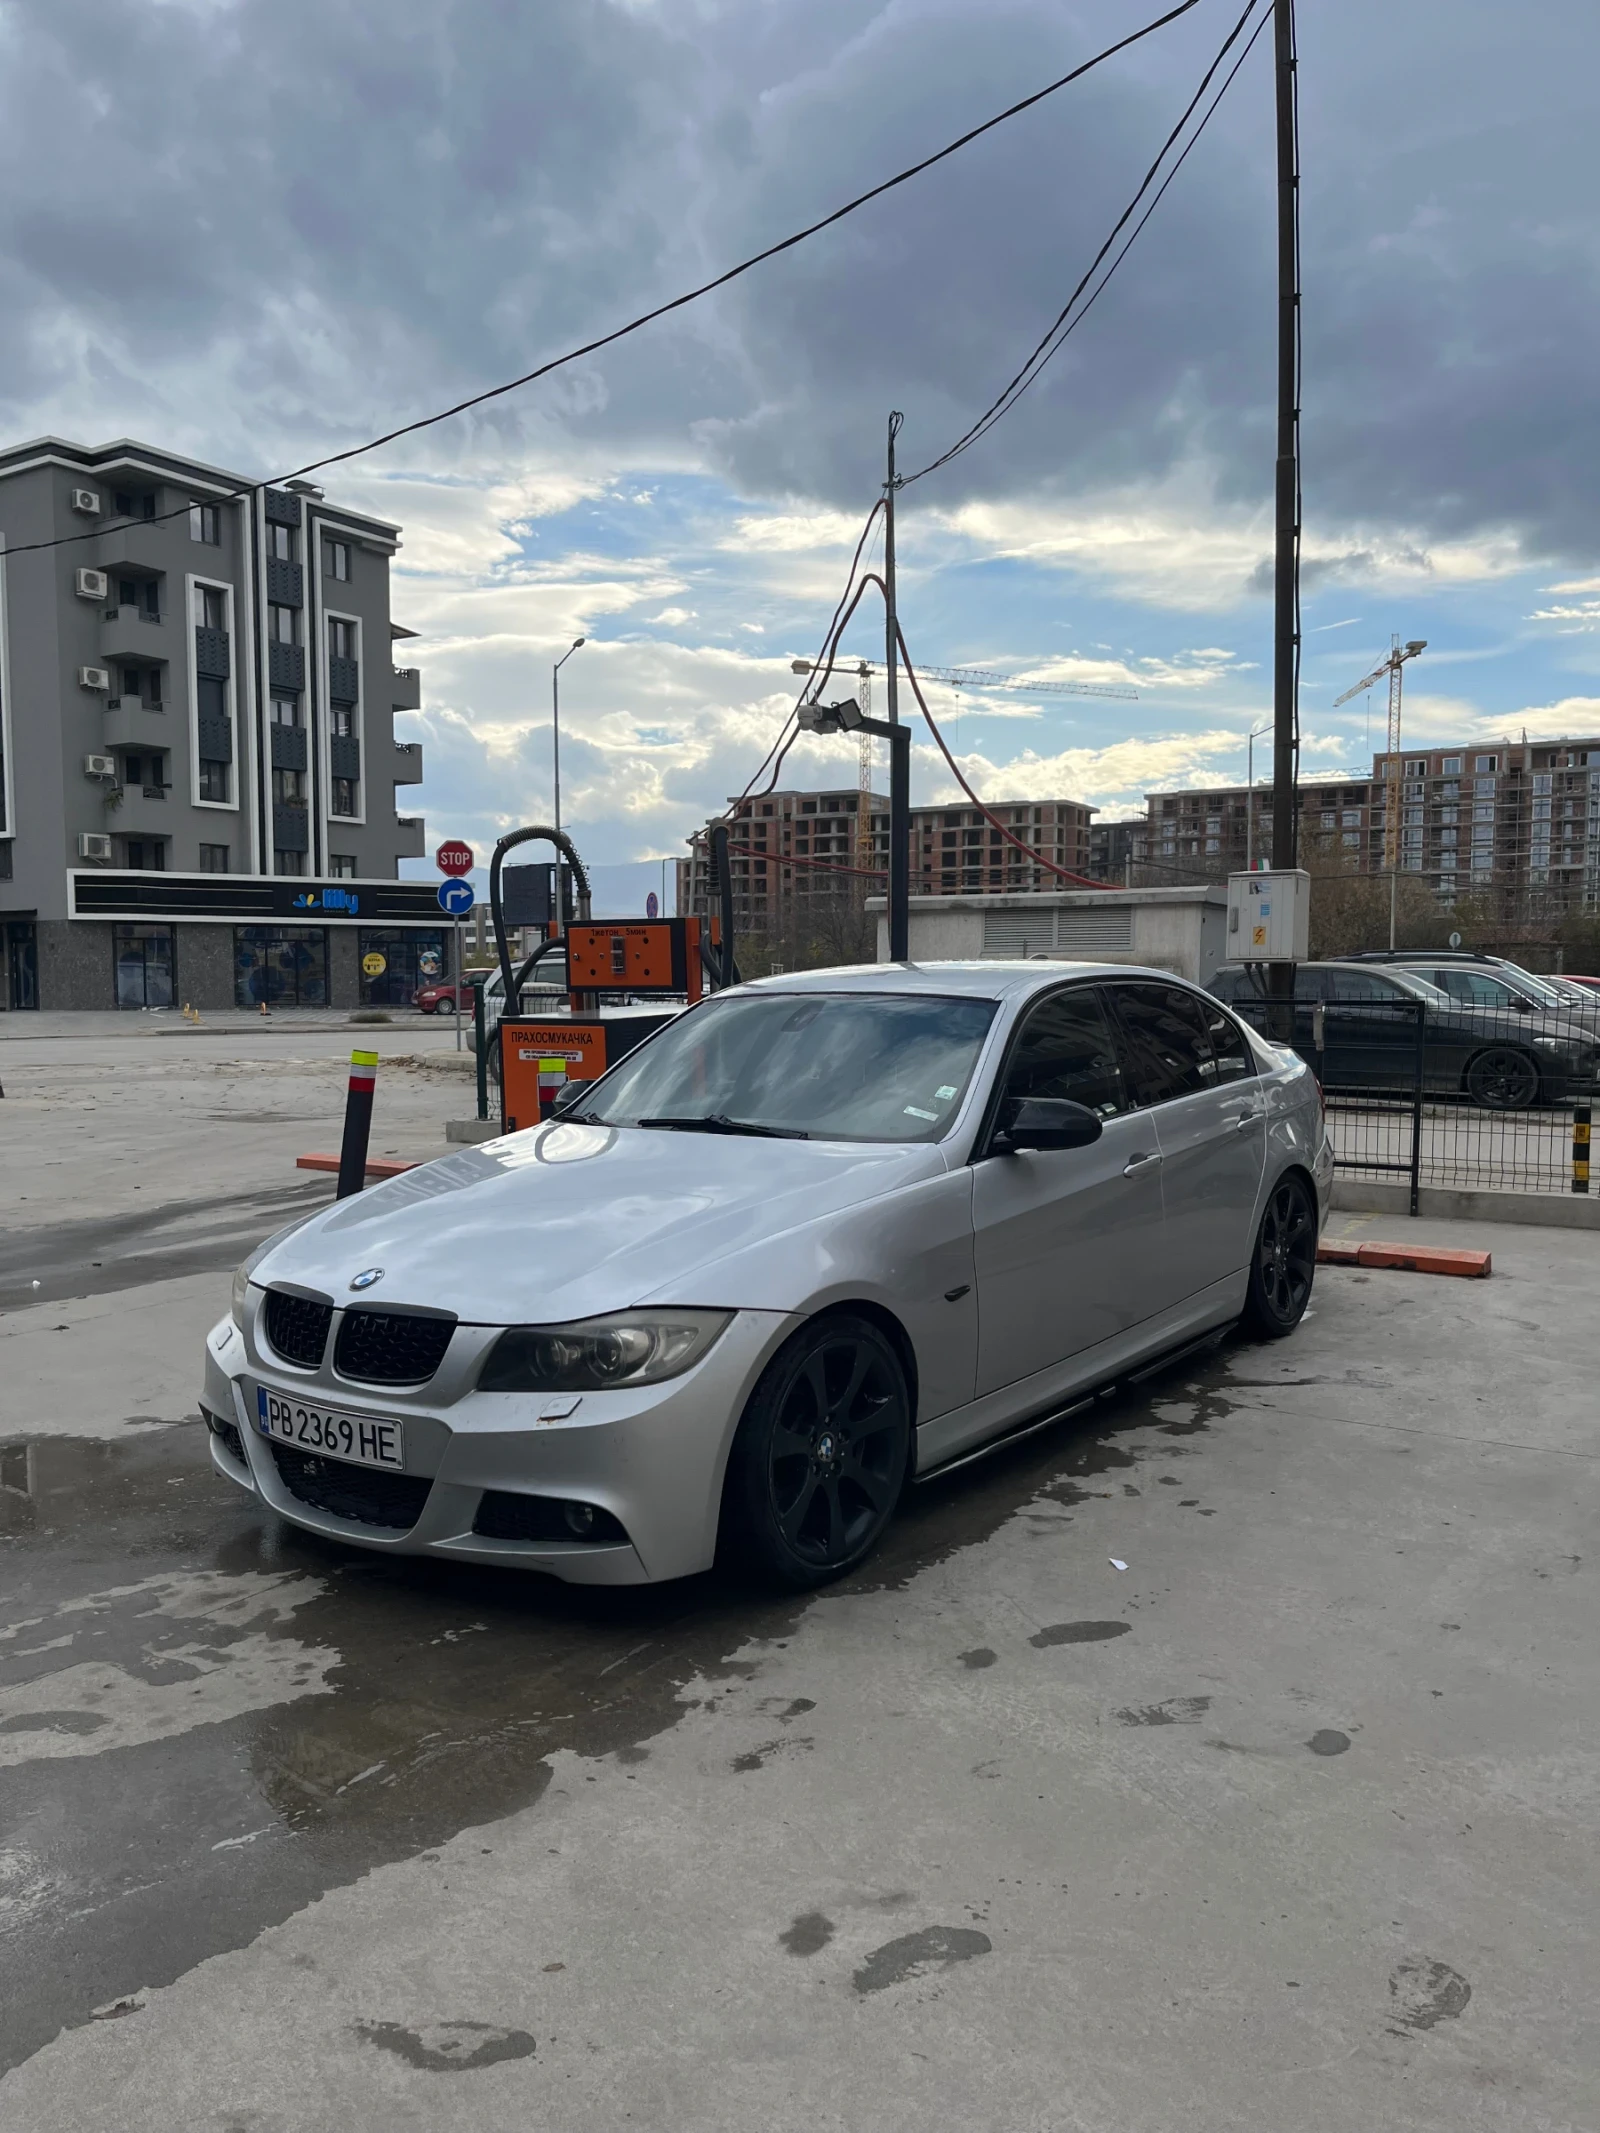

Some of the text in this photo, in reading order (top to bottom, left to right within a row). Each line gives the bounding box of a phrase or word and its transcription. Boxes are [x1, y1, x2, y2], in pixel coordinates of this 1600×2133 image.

[440, 852, 470, 865] STOP
[322, 888, 358, 914] lilly
[511, 1032, 593, 1044] ПРАХОСМУКАЧКА
